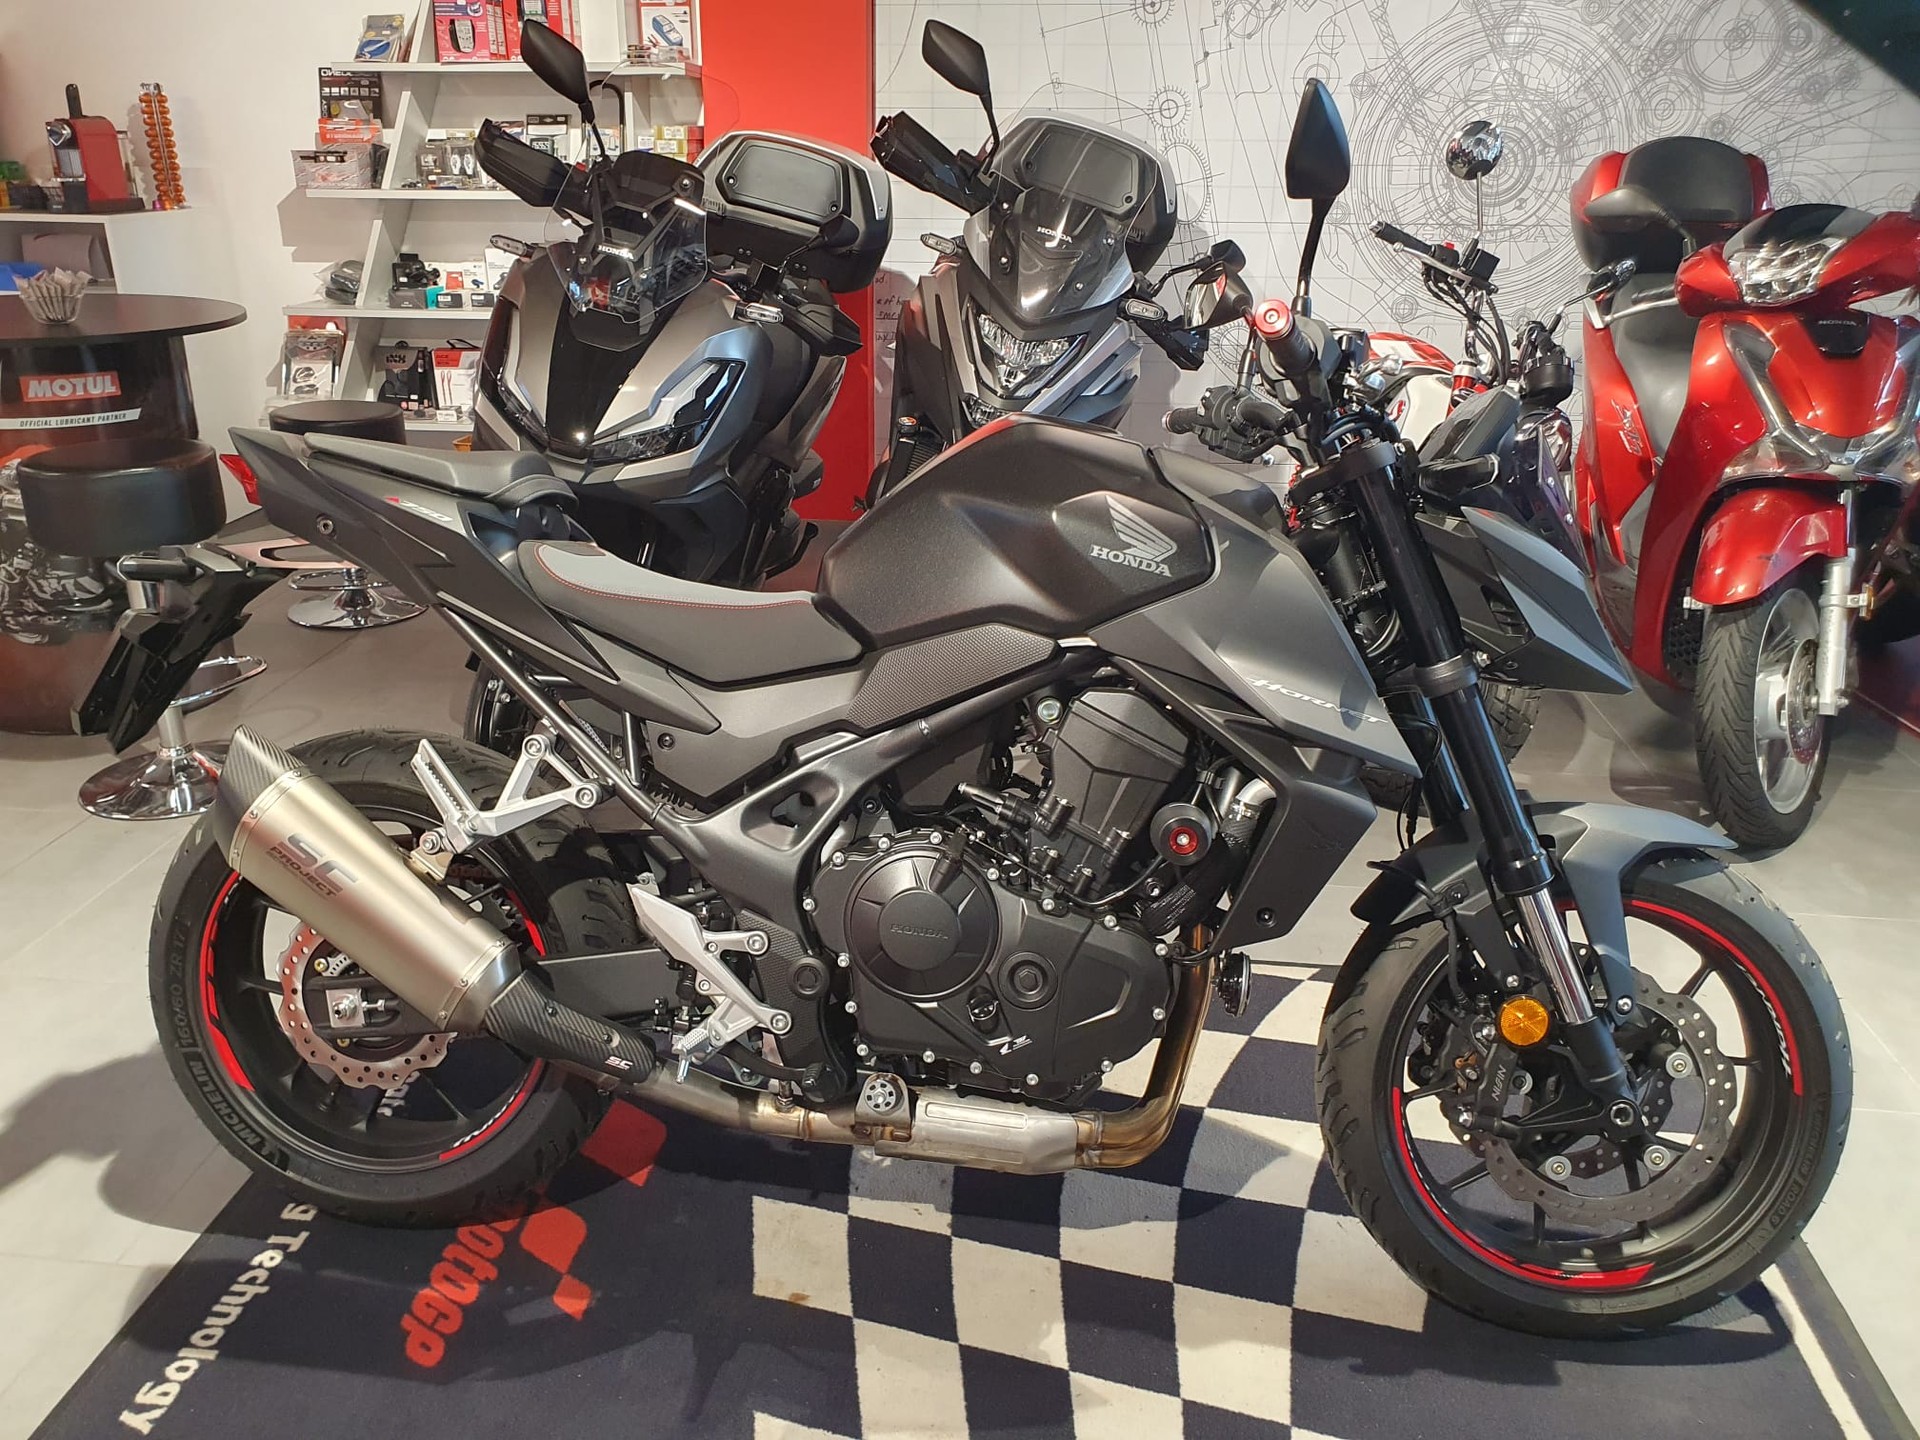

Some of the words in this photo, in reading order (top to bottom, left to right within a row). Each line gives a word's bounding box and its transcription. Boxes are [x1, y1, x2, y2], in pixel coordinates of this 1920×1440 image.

[28, 375, 117, 398] MOTUL
[20, 419, 52, 427] OFFICIAL
[55, 416, 95, 426] LUBRICANT
[98, 413, 127, 422] PARTNER
[1089, 544, 1173, 577] HONDA
[269, 846, 337, 896] PROJECT
[278, 833, 358, 894] SC
[890, 923, 949, 940] HONDA
[169, 954, 187, 976] ZR
[189, 1060, 262, 1148] MICHELIN
[401, 1217, 520, 1368] otoGP
[118, 1229, 310, 1436] Technology
